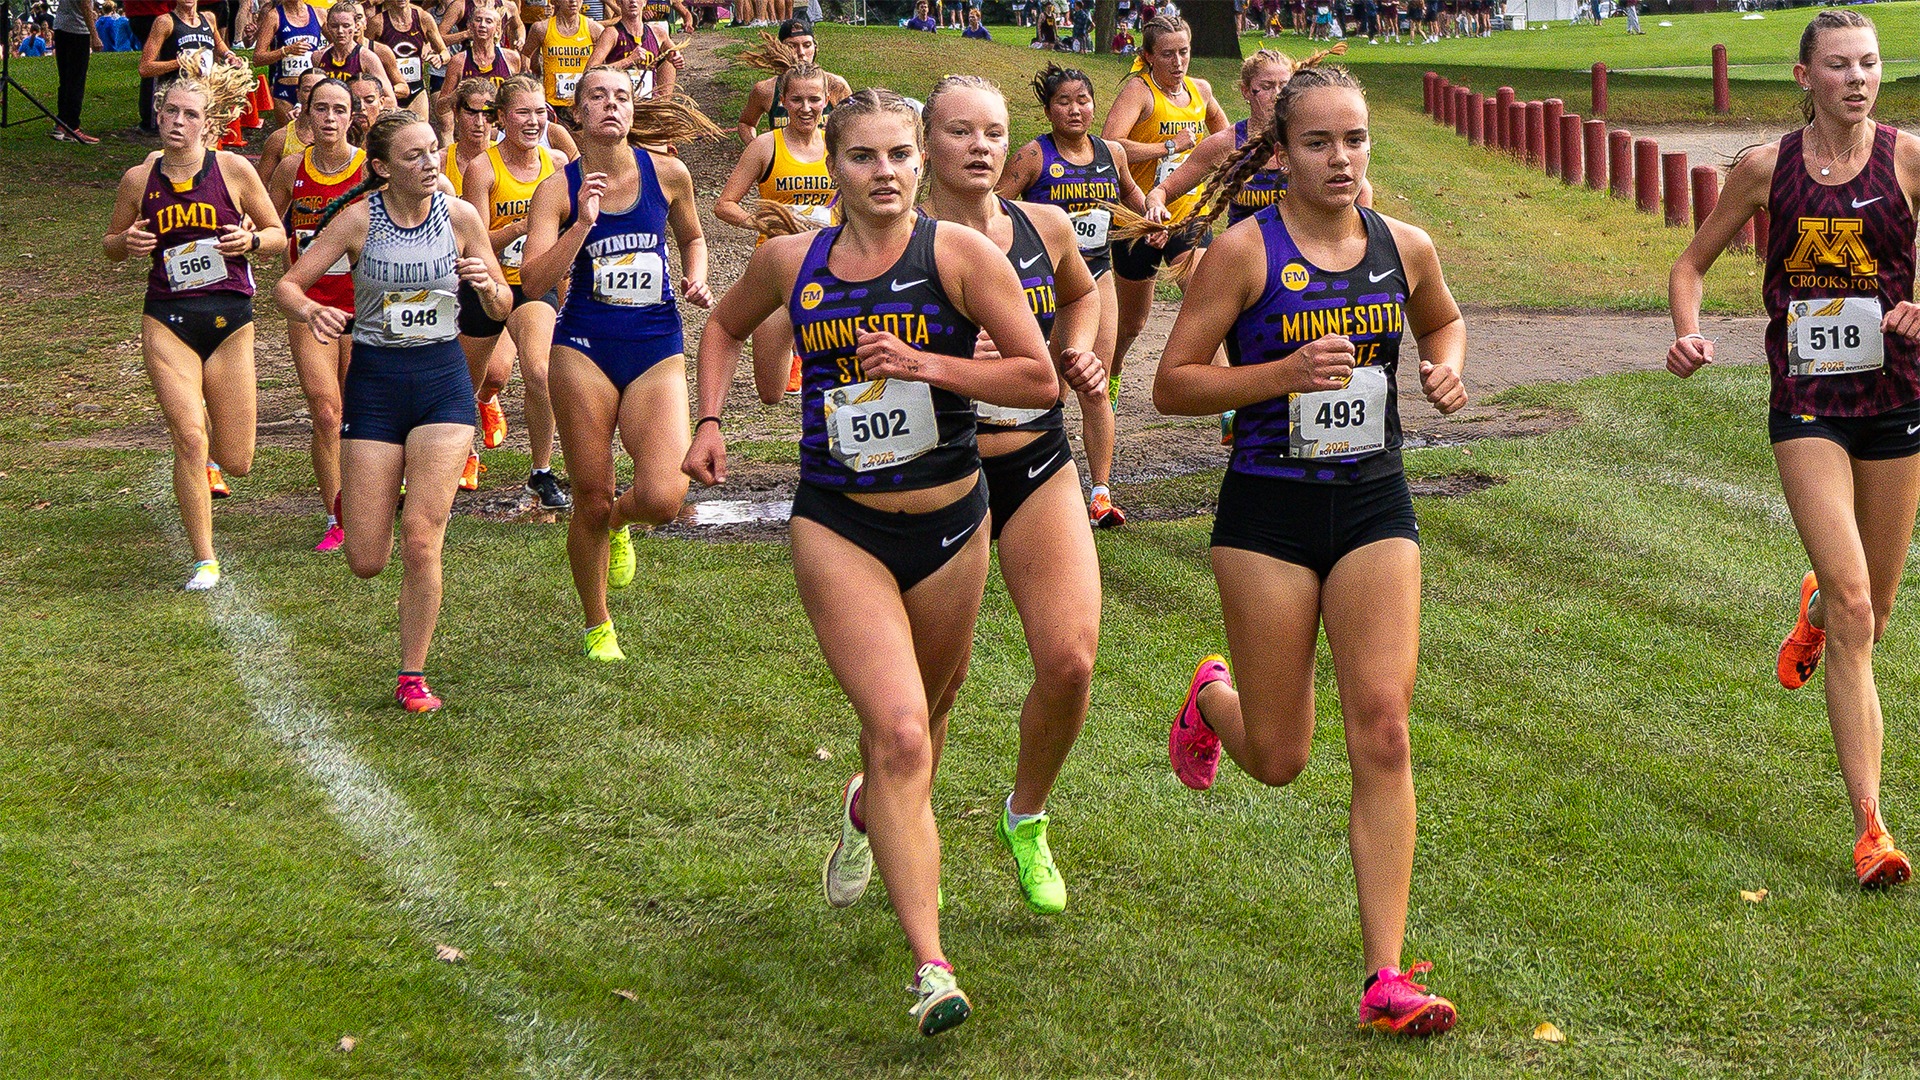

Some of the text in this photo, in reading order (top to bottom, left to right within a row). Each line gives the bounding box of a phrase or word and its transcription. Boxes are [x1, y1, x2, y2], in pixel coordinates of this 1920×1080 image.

[178, 34, 197, 46] SIOUX
[547, 46, 590, 56] MICHIGAN
[287, 60, 309, 68] 1214
[558, 58, 581, 66] TECH
[564, 82, 575, 91] 40
[776, 176, 839, 191] MICHIGA
[1050, 183, 1117, 200] MINNESOTA
[793, 193, 830, 206] TECH
[1237, 189, 1288, 207] MINNES
[157, 202, 217, 234] UMD
[585, 233, 658, 258] WINONA
[1784, 217, 1878, 277] M
[179, 255, 211, 276] 566
[363, 254, 389, 282] SOUTH
[393, 261, 429, 283] DAKOTA
[605, 271, 652, 290] 1212
[1284, 271, 1307, 283] FM
[1789, 274, 1879, 291] CROOKSTON
[802, 289, 821, 303] FM
[401, 309, 437, 327] 948
[1281, 302, 1402, 343] MINNESOTA
[1810, 324, 1861, 350] 518
[1820, 360, 1845, 369] 2025
[1315, 399, 1366, 430] 493
[851, 408, 911, 443] 502
[1326, 441, 1350, 451] 2025
[867, 450, 895, 463] 2025
